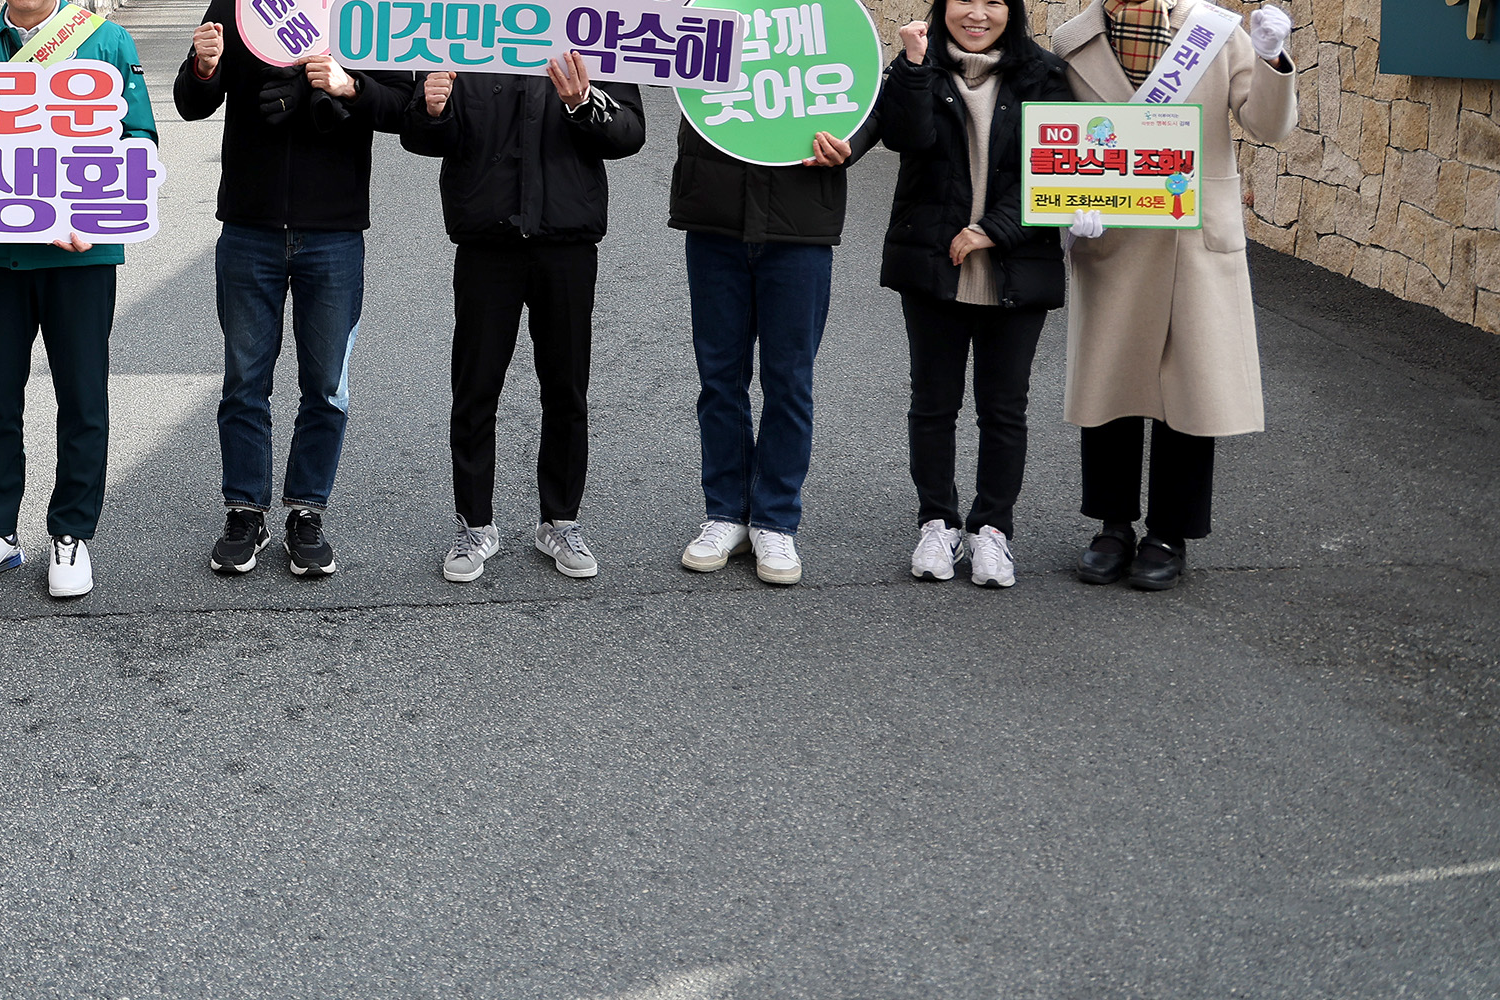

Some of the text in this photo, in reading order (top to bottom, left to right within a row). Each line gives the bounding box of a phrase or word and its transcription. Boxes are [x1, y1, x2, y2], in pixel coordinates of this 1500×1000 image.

[339, 0, 735, 83] 이것만은 약속해
[1046, 128, 1073, 142] NO
[1030, 148, 1129, 176] 플라스틱
[1034, 194, 1167, 209] 관내 조화쓰레기 43톤
